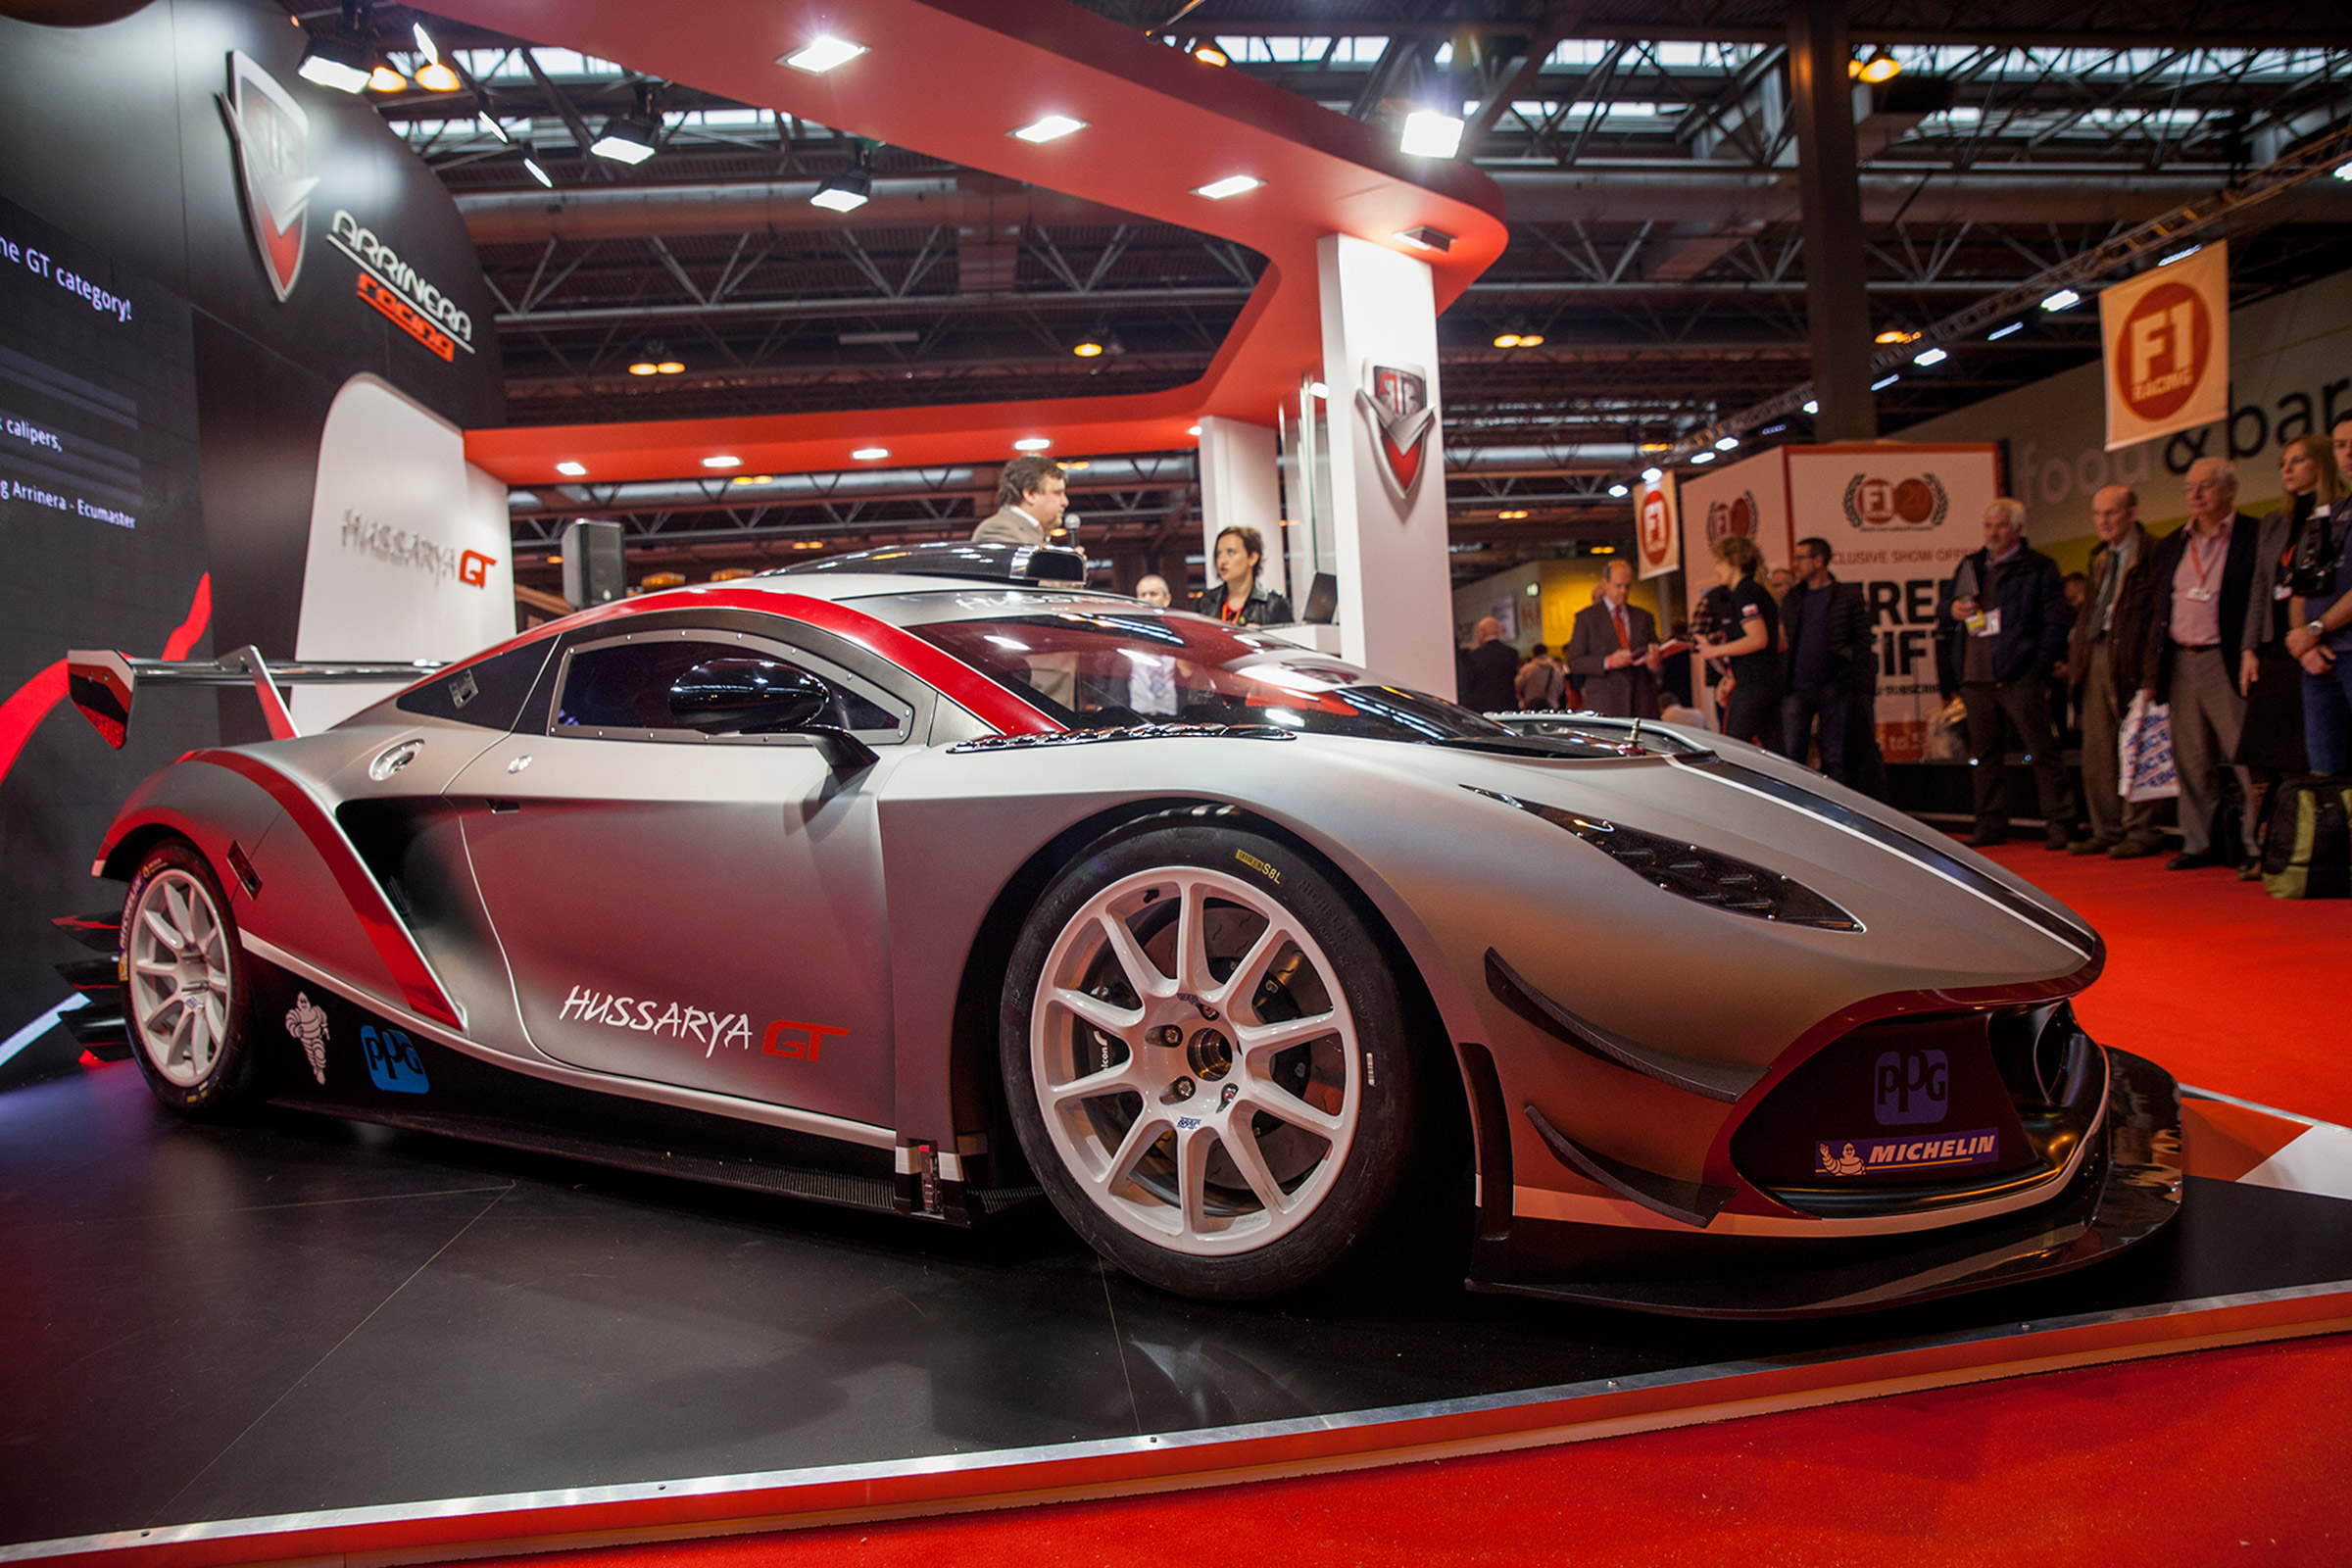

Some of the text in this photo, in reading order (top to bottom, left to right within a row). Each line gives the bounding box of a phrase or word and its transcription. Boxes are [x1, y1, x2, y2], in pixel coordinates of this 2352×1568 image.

[25, 247, 50, 278] GT
[56, 267, 132, 322] category!
[331, 209, 472, 342] ARRINERA
[2130, 298, 2195, 384] F1
[2131, 369, 2195, 404] RACING
[6, 418, 63, 452] calipers,
[2228, 378, 2350, 461] bar
[13, 480, 67, 511] Arrinera
[77, 498, 136, 529] Ecumaster
[460, 549, 498, 589] GT
[1831, 550, 1886, 565] CLUSIVE
[1891, 549, 1933, 564] SHOW
[1261, 862, 1281, 884] S8L
[559, 985, 852, 1062] HUSSARYA GT
[364, 1029, 423, 1080] PPG
[1877, 1051, 1946, 1113] PPG
[1869, 1135, 1995, 1164] MICHELIN
